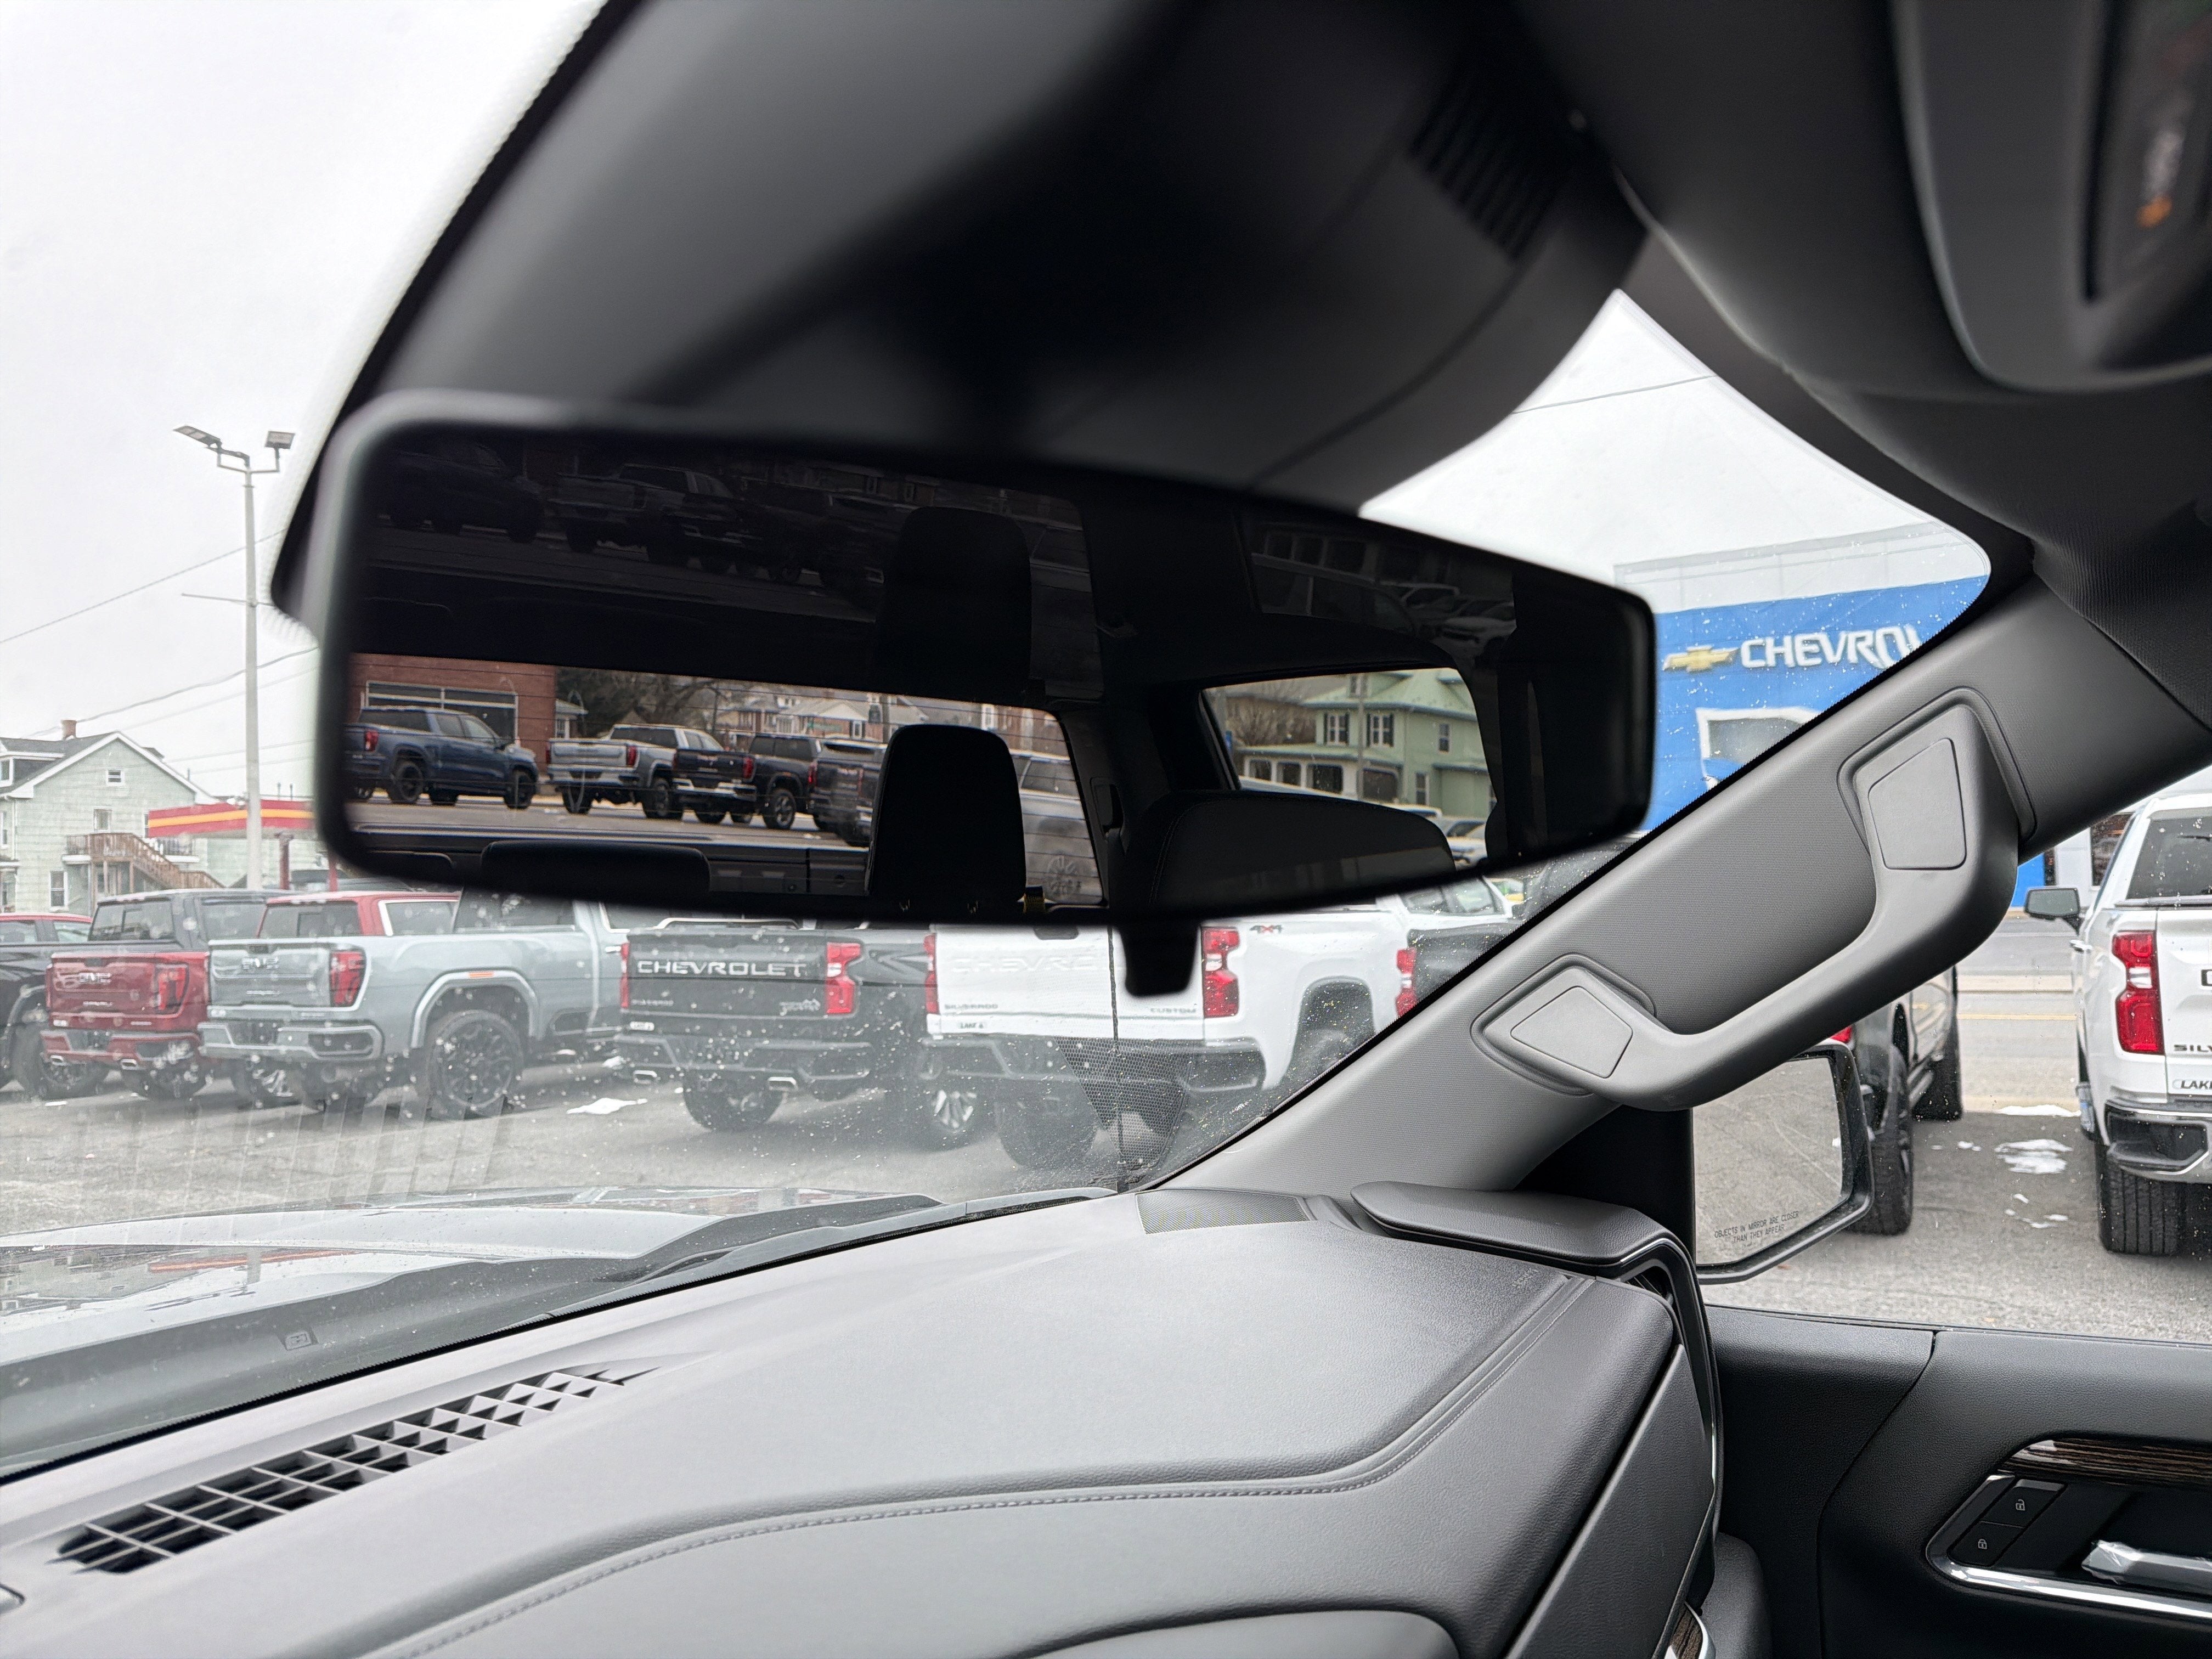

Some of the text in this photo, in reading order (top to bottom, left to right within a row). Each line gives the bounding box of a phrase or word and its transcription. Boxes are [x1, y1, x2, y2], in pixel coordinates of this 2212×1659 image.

[637, 961, 807, 977] CHEVROLET
[1714, 1226, 1738, 1238] OBJECTS
[1748, 1219, 1767, 1231] MIRROR
[1769, 1216, 1779, 1224] ARE
[1781, 1210, 1799, 1222] CLOSER
[1733, 1224, 1785, 1244] THAN THEY APPEAR
